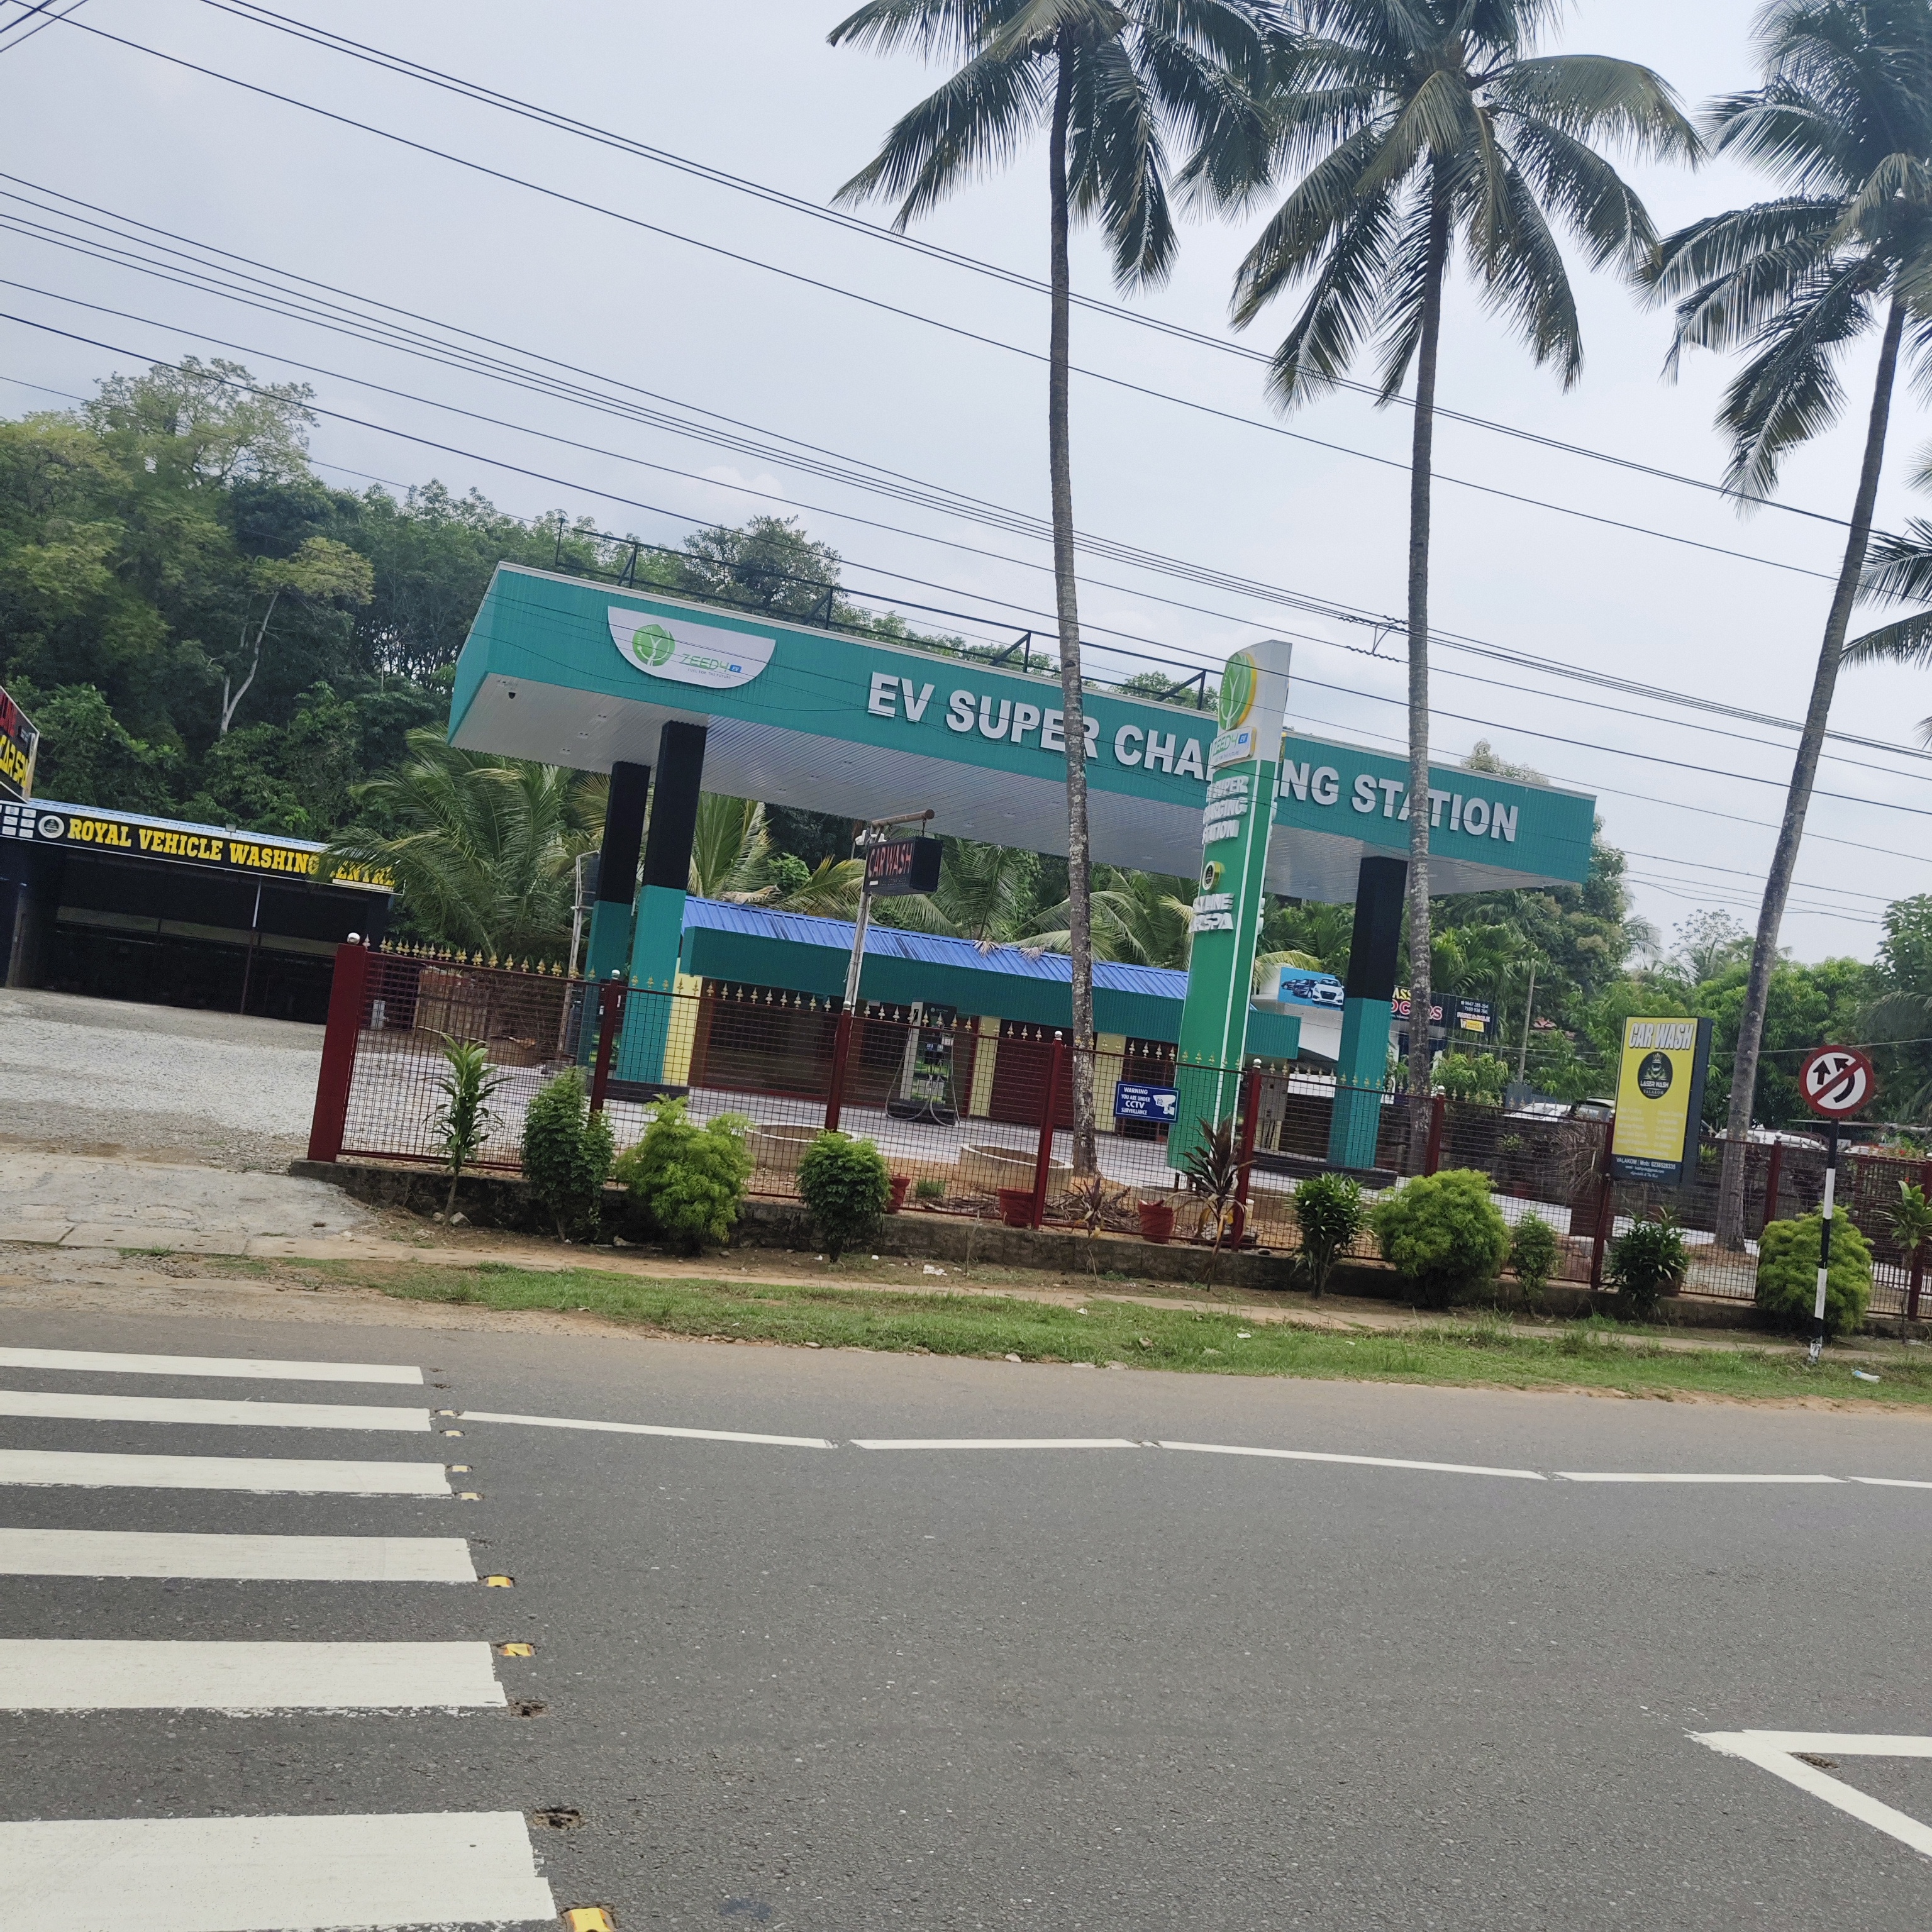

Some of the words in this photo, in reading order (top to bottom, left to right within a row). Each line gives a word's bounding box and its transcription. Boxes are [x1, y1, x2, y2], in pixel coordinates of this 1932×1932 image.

[867, 671, 935, 723] EV
[946, 690, 1100, 758] SUPER
[1114, 724, 1339, 806] CHANG
[67, 818, 131, 847] ROYAL
[139, 828, 223, 861] VEHICLE
[230, 843, 320, 875] WASHING
[869, 847, 886, 878] CAR
[886, 843, 913, 876] WASH
[1628, 1022, 1654, 1049] CAR
[1655, 1023, 1694, 1050] WASH
[1124, 1087, 1148, 1095] WARNING
[1125, 1100, 1145, 1109] CCTV
[1121, 1107, 1148, 1116] SURVEILLANCE
